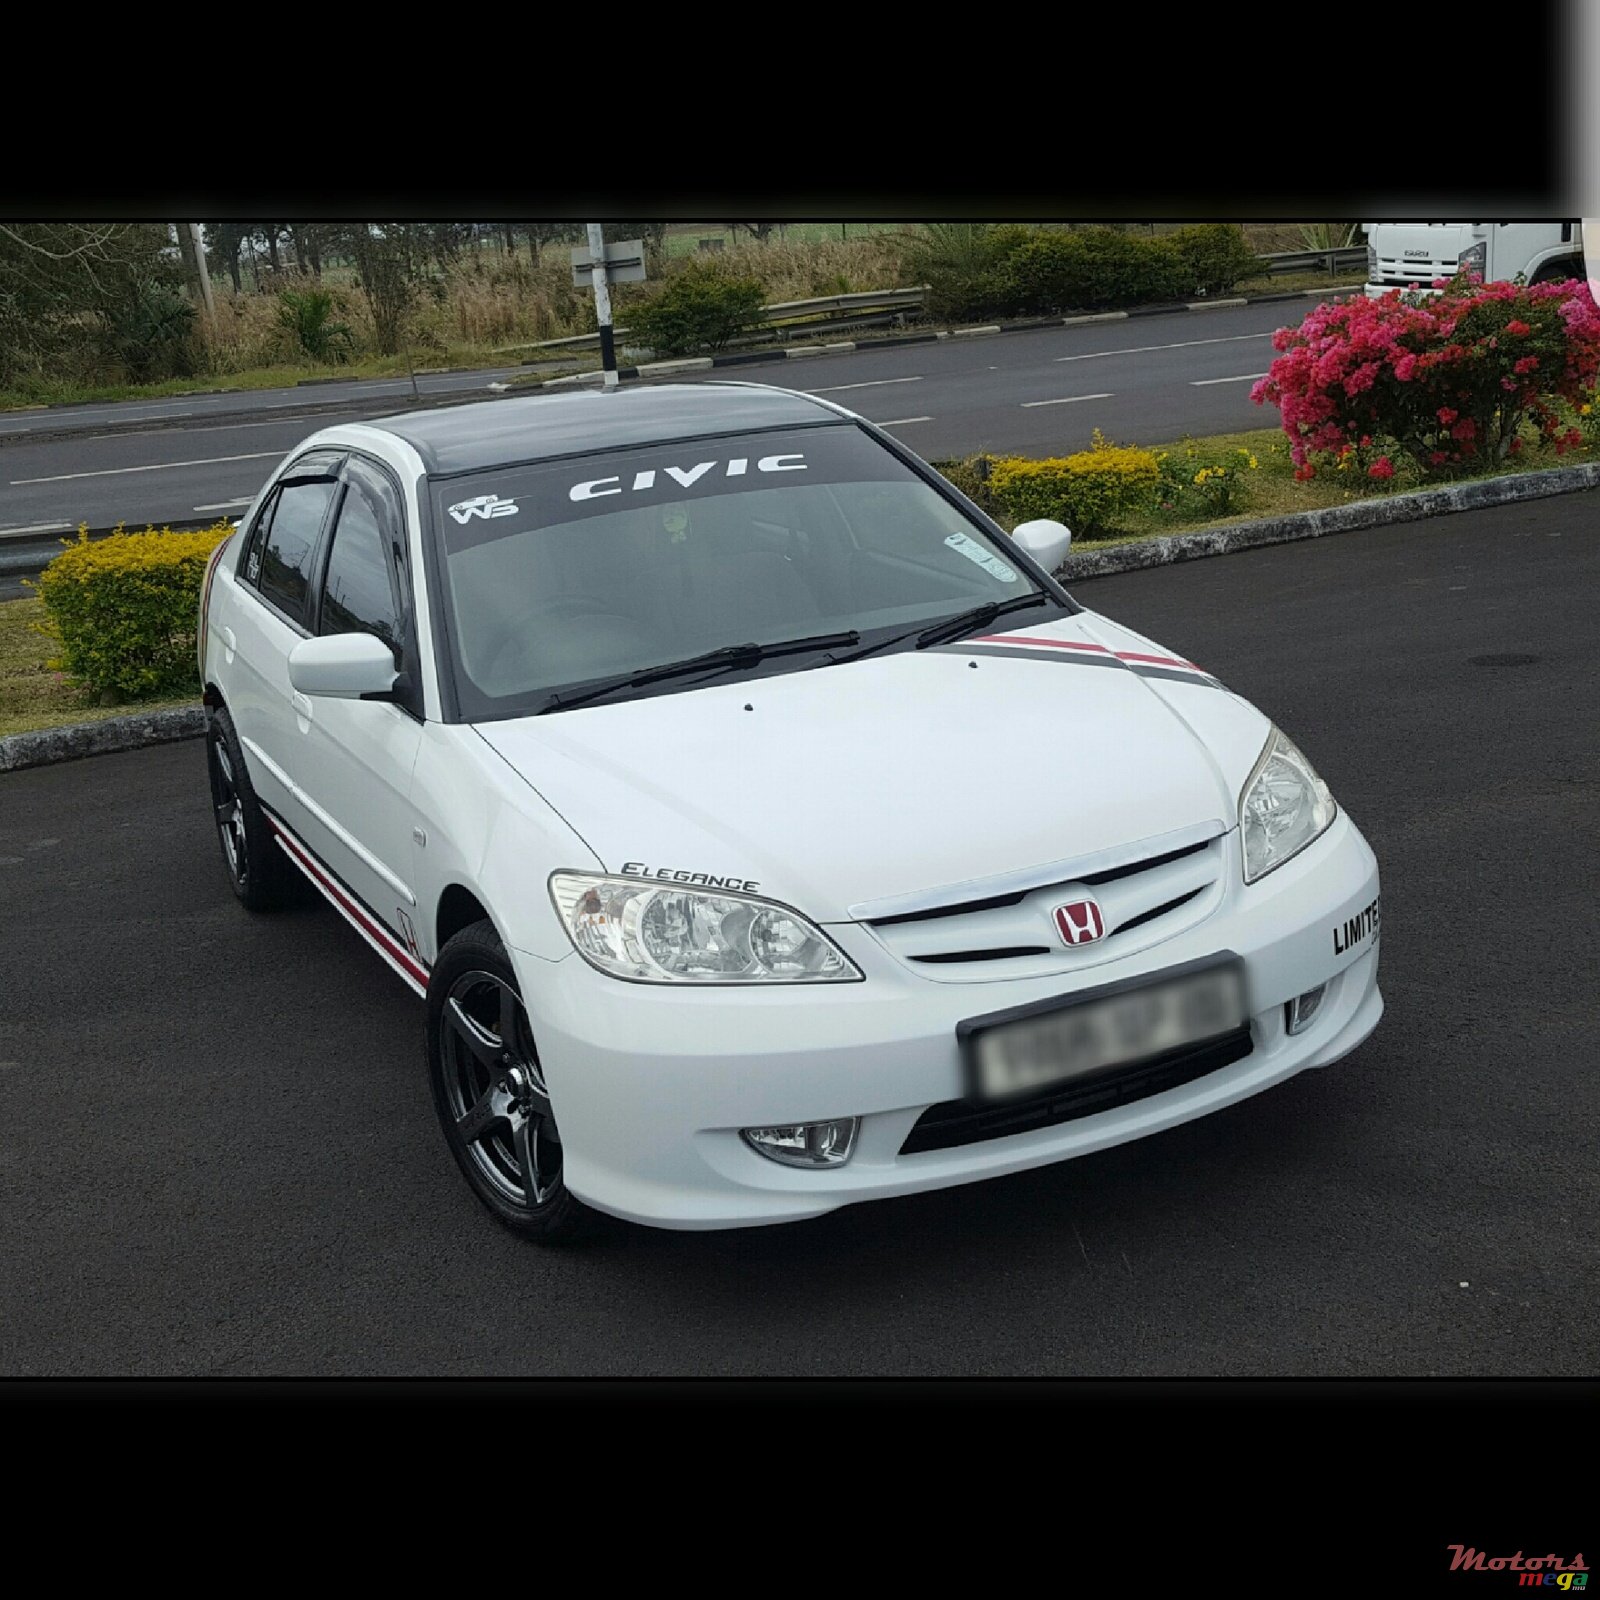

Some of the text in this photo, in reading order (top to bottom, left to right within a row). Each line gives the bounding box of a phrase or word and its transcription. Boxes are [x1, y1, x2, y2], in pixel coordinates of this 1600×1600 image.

[569, 453, 808, 502] CIVIC
[620, 862, 761, 893] ELEGANCE
[1333, 895, 1381, 956] LIMITE
